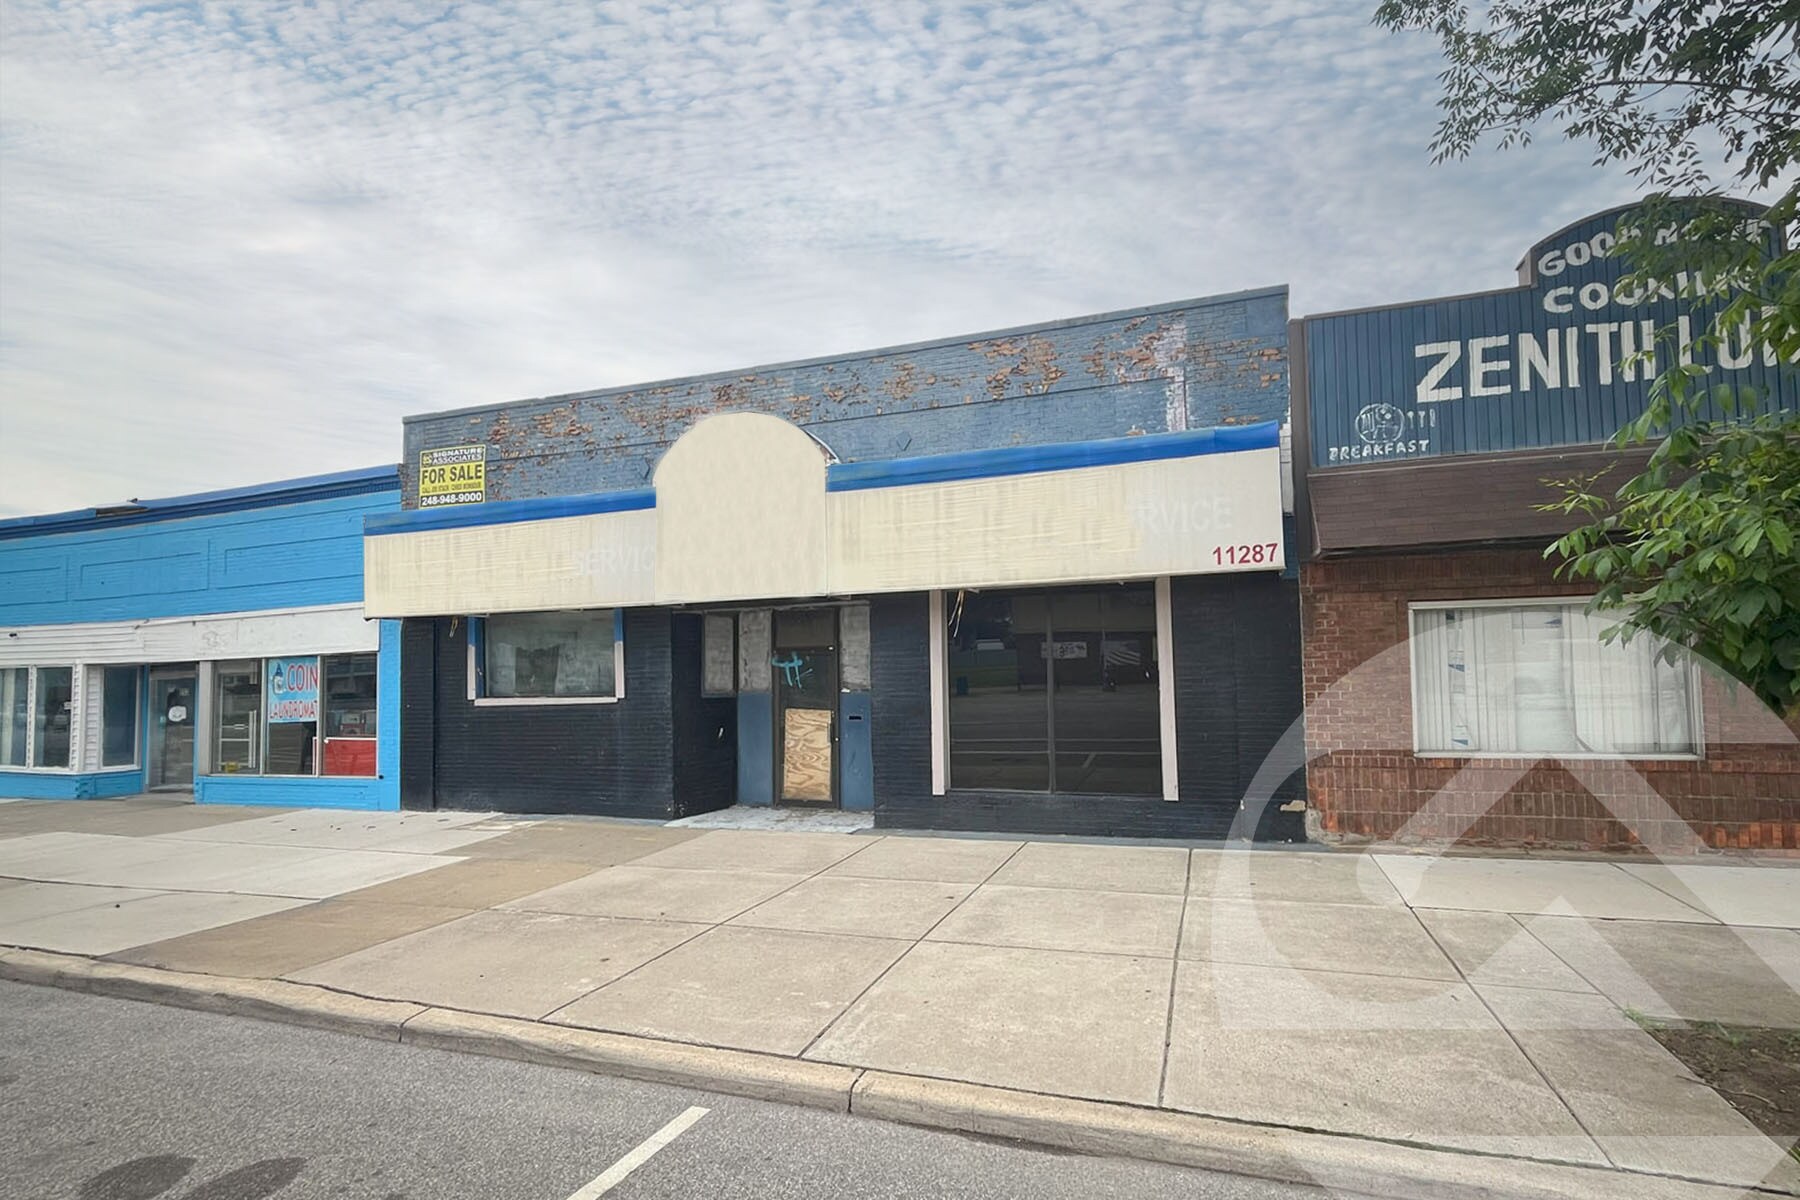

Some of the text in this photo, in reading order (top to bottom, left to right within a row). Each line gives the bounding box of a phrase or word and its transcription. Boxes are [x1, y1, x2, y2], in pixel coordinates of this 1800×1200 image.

[1415, 319, 1657, 404] ZENITH
[432, 447, 482, 458] SIGNATURE
[432, 454, 482, 465] ASSOCIATES
[1328, 440, 1430, 461] BREAKFAST
[422, 464, 483, 485] FOR SALE
[421, 492, 482, 506] 248-948-9000
[1212, 543, 1279, 565] 11287
[287, 664, 319, 691] COIN
